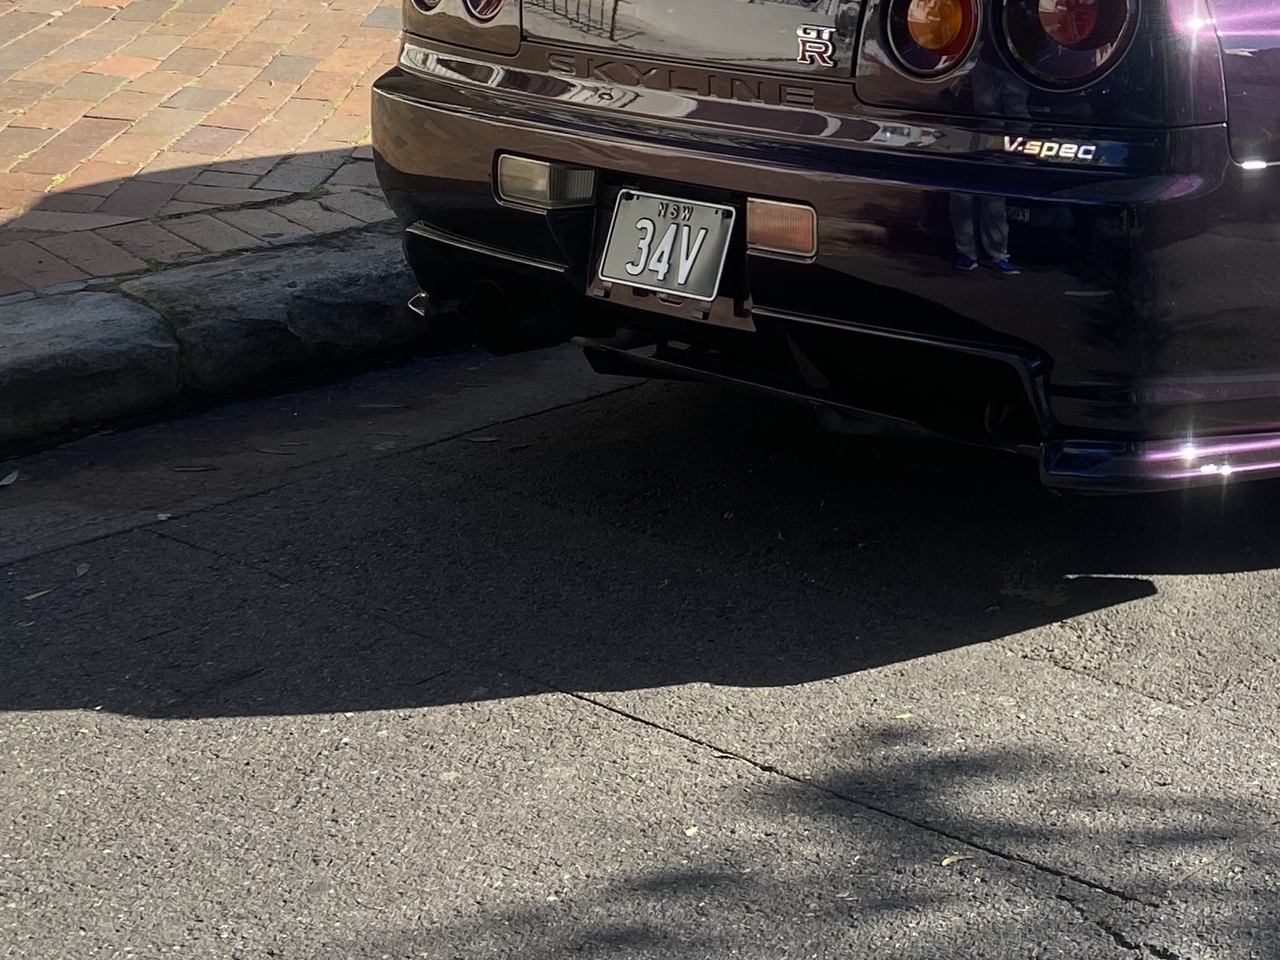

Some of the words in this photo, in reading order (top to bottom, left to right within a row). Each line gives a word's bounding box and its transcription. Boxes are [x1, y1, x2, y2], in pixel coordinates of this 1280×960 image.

[548, 52, 815, 110] SKYLINE
[657, 202, 694, 222] NSW
[625, 217, 709, 286] 34V
